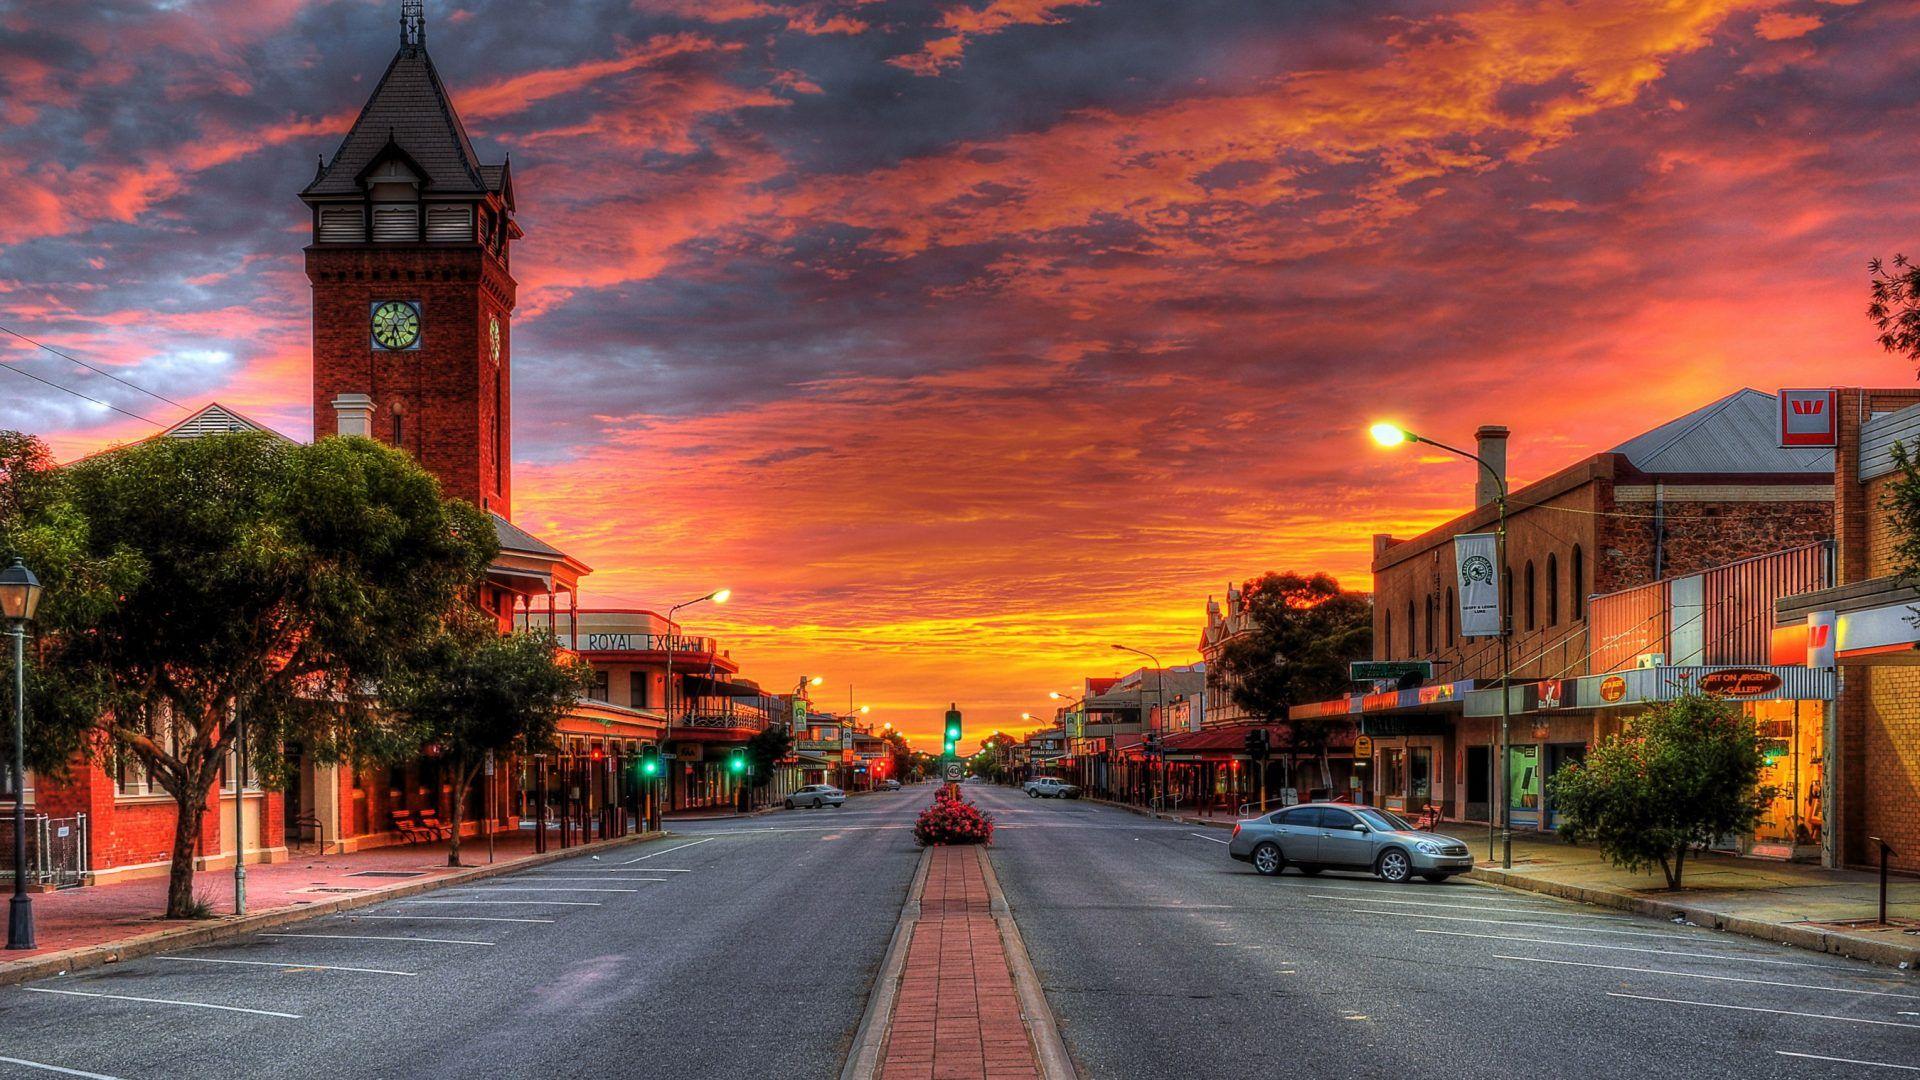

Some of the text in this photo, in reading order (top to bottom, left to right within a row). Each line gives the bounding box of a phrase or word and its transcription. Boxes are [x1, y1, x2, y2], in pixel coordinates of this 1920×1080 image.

[589, 634, 636, 651] ROYAL
[1707, 673, 1772, 682] ART ON ARGENT
[1727, 686, 1763, 694] GALLERY
[949, 767, 959, 775] 40
